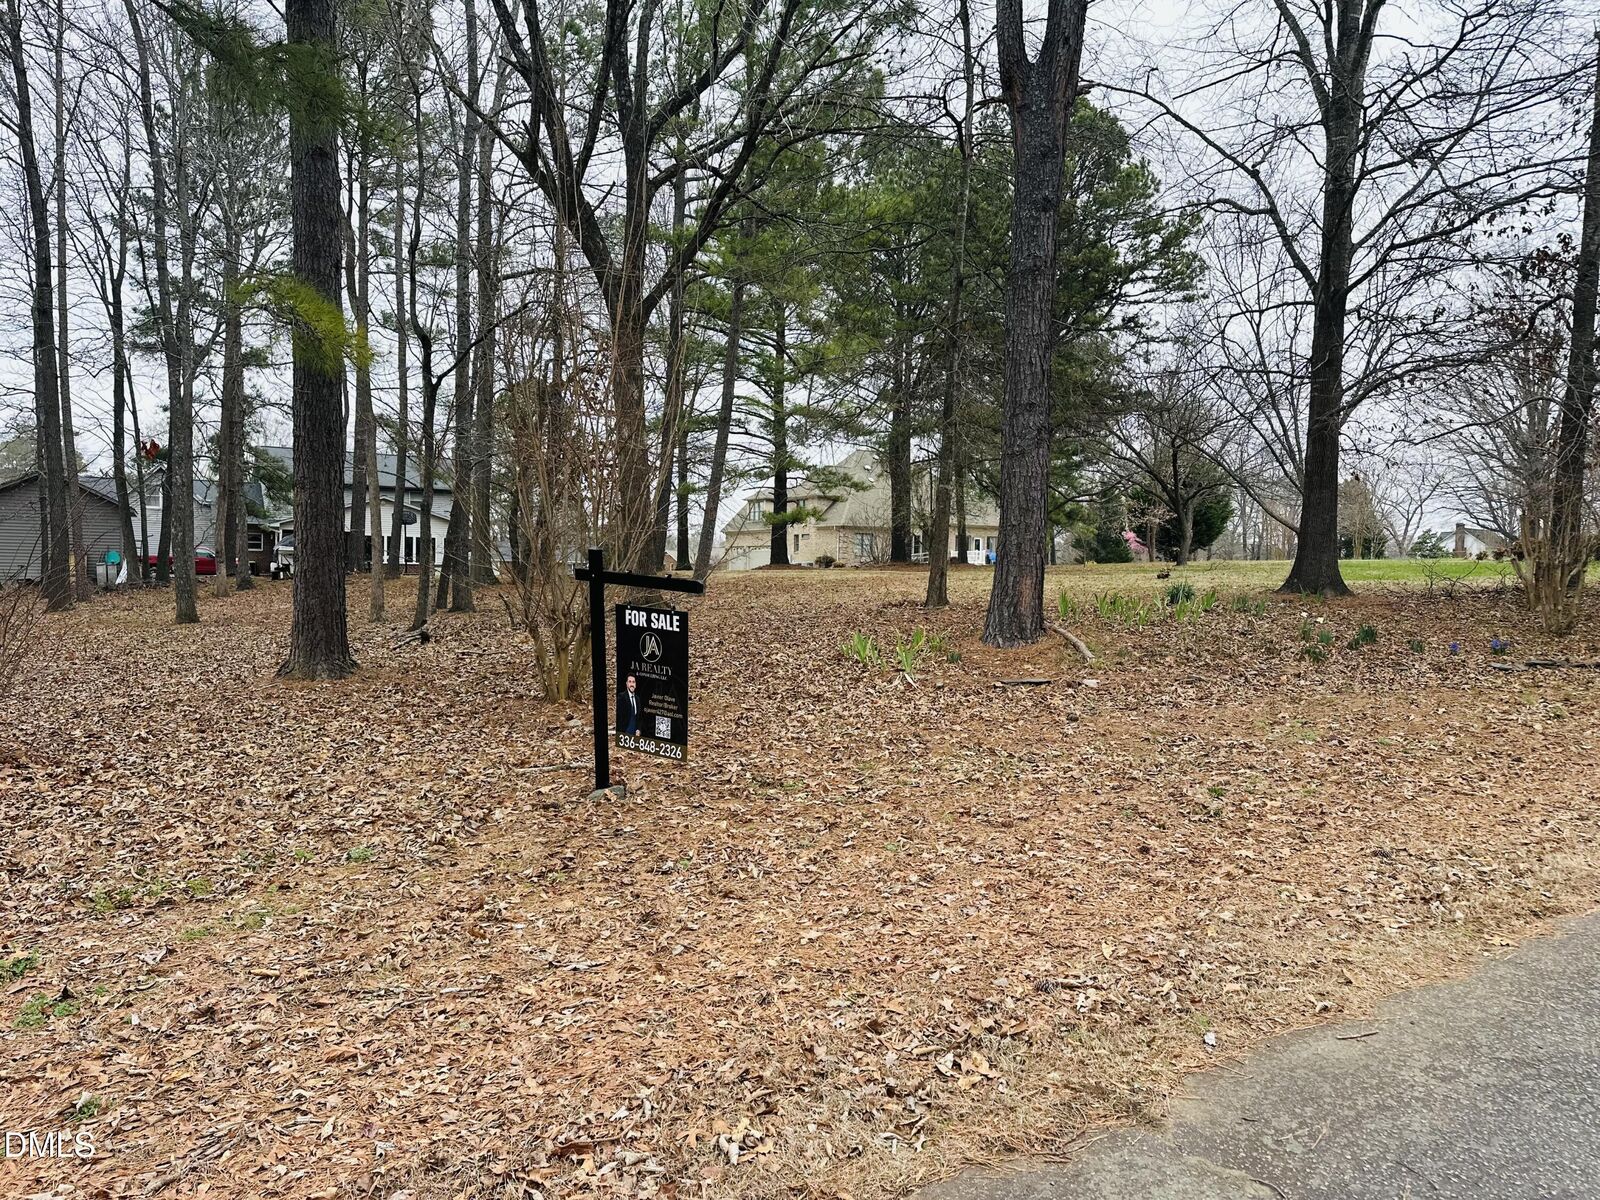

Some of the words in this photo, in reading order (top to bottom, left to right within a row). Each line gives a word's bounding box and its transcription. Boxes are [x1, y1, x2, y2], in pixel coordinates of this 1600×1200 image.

[625, 609, 647, 628] FOR
[650, 612, 680, 632] SALE
[643, 635, 660, 657] JA
[630, 660, 640, 671] JA
[641, 662, 673, 676] REALTY
[618, 734, 682, 759] 336-848-2326
